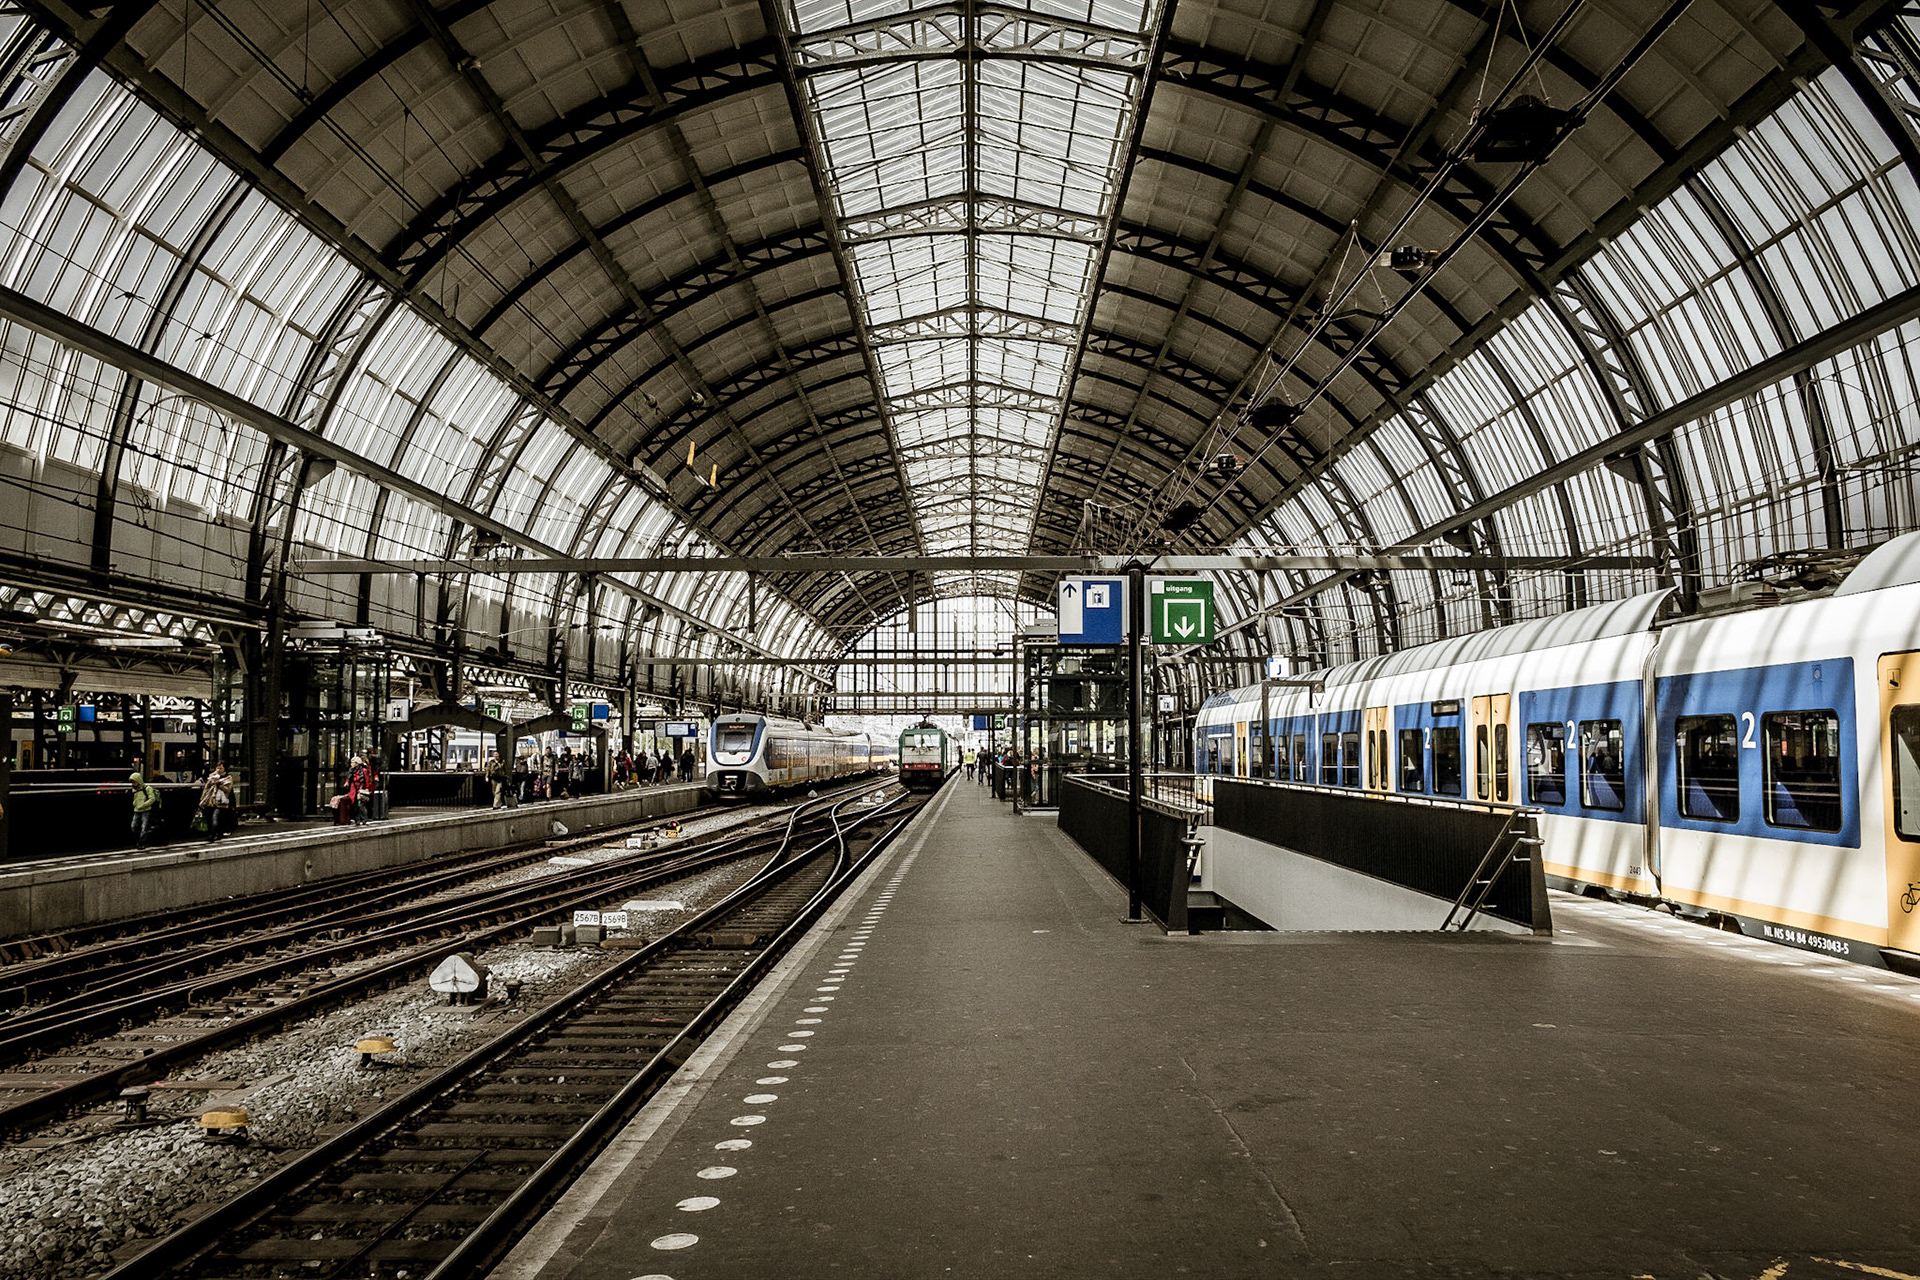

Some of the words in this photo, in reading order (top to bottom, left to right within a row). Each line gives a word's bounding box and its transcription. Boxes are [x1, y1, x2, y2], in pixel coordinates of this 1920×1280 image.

[1165, 585, 1193, 594] uitgang
[1566, 719, 1577, 749] 2
[1741, 711, 1757, 749] 2
[1337, 731, 1343, 750] 2
[1424, 726, 1431, 750] 2
[69, 749, 73, 758] 2
[119, 749, 124, 758] 2
[574, 913, 599, 923] 2567B
[603, 914, 627, 924] 2569B
[1763, 925, 1773, 937] NL
[1774, 927, 1784, 940] NS
[1785, 929, 1795, 942] 94
[1796, 932, 1806, 945] 84
[1807, 935, 1849, 955] 4953043-5
